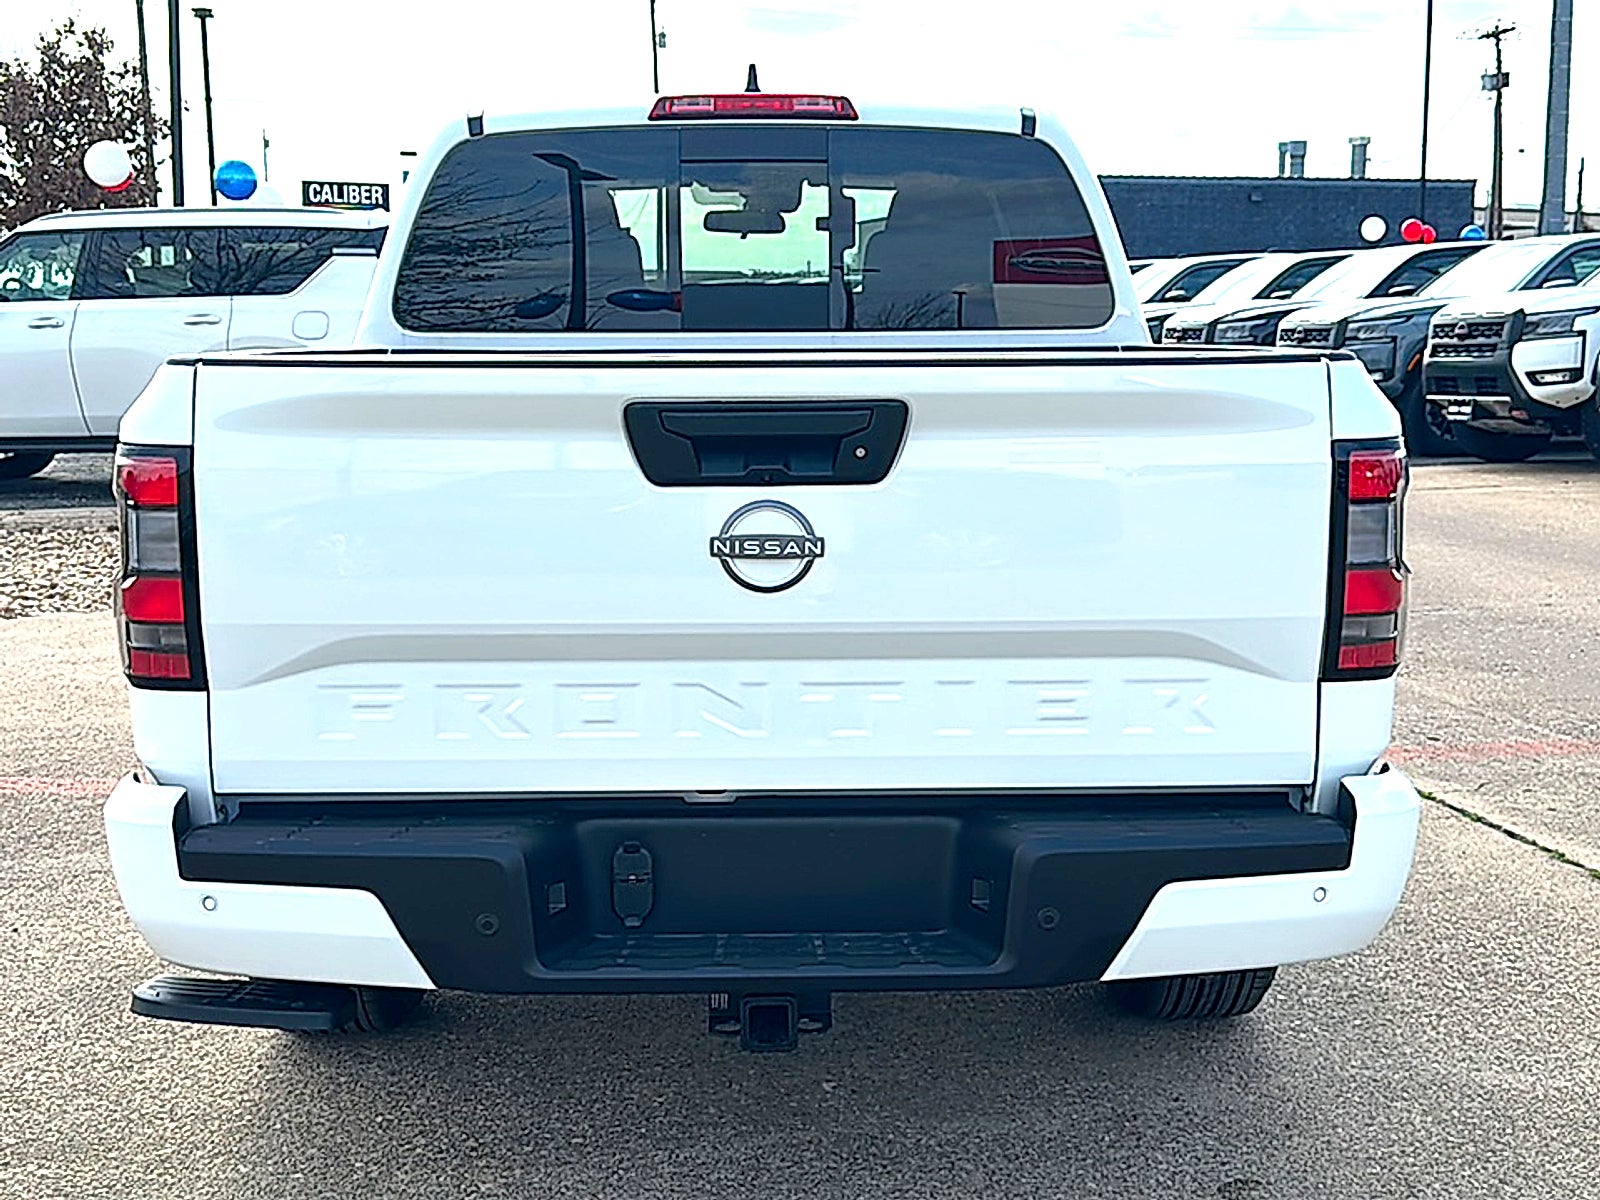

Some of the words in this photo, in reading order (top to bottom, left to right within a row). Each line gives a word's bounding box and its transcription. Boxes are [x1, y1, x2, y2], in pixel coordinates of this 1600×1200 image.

[309, 184, 383, 204] CALIBER
[713, 539, 822, 555] NISSAN
[316, 678, 1216, 740] FRONTIER
